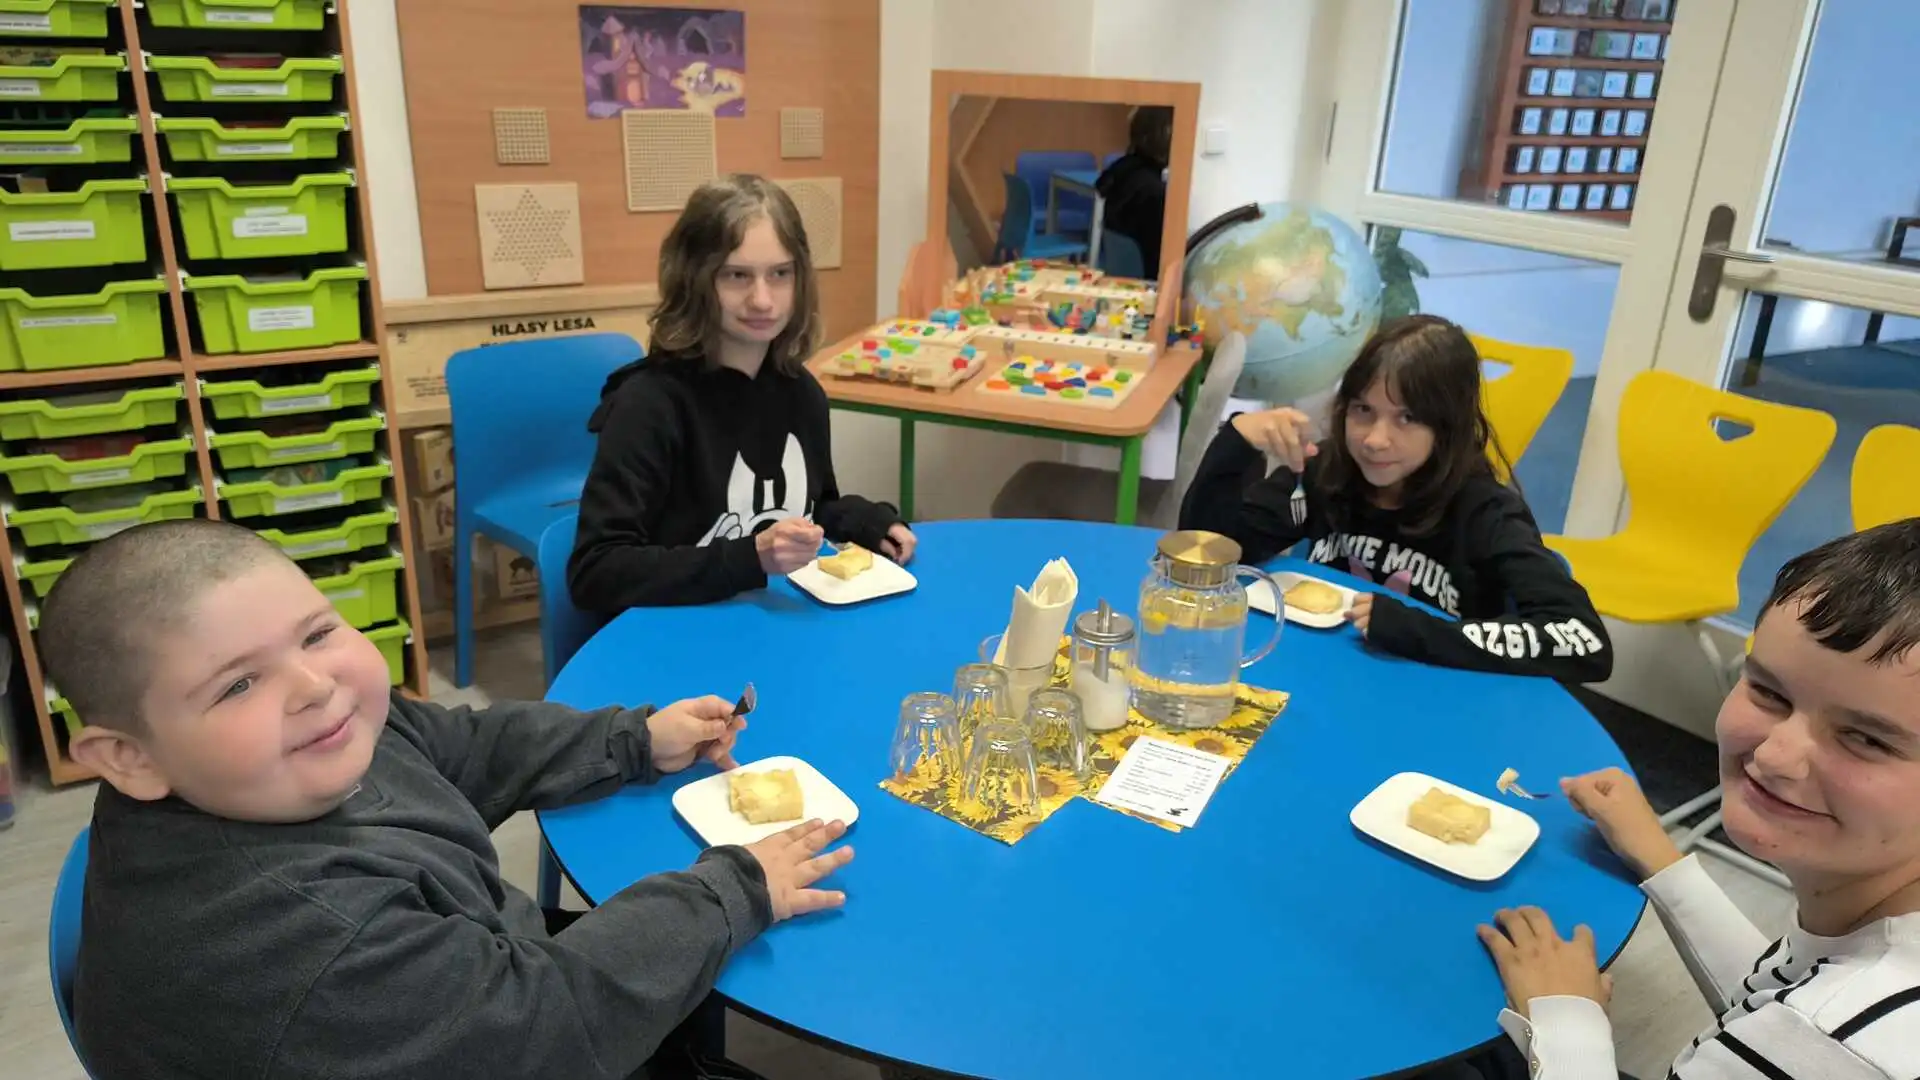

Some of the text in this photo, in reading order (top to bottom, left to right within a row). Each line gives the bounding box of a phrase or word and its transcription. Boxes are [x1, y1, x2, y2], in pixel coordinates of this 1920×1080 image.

[492, 317, 595, 337] HLASY LESA
[1307, 532, 1383, 570] MNIE
[1543, 617, 1603, 658] EST
